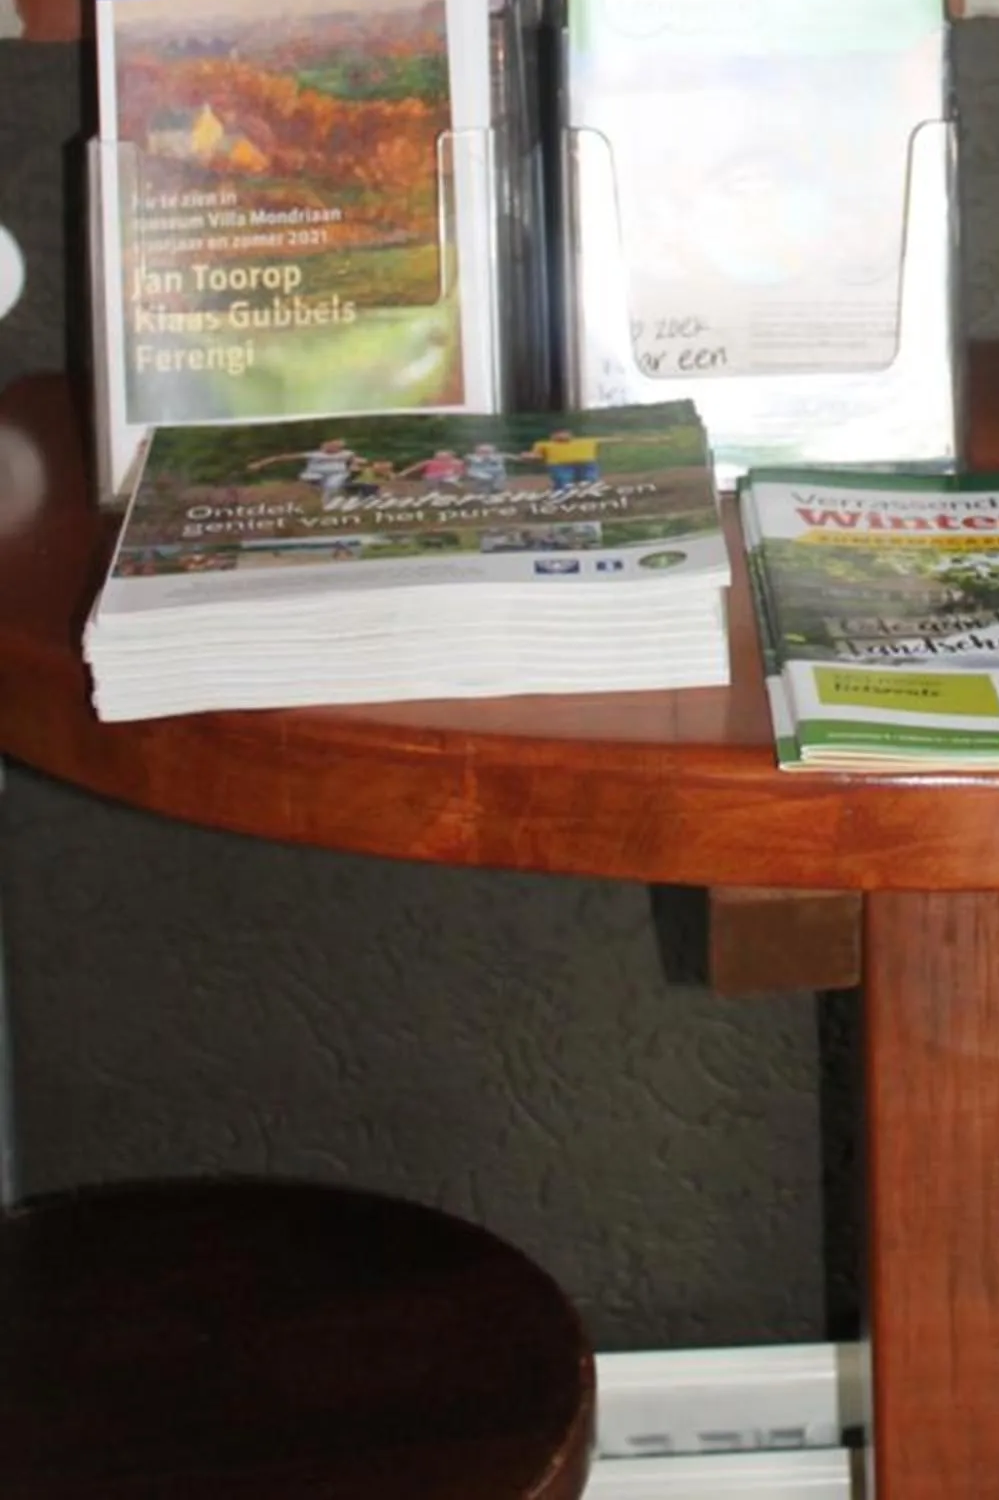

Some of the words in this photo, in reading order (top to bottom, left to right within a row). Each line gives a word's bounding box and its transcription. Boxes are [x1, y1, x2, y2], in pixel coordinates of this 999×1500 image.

[208, 210, 247, 229] Villa
[249, 207, 342, 226] Mondriaan
[285, 229, 329, 245] 2021
[133, 266, 184, 299] Jan
[192, 264, 302, 299] Toorop
[134, 303, 220, 334] Klaas
[228, 293, 357, 328] Gubbels
[135, 339, 255, 375] Ferengi
[677, 346, 728, 371] een
[186, 501, 305, 520] Ontdek
[615, 483, 657, 495] en
[791, 491, 998, 511] Verrassend
[181, 517, 285, 538] geniet
[301, 515, 361, 528] van
[374, 510, 424, 524] het
[438, 507, 518, 523] pure
